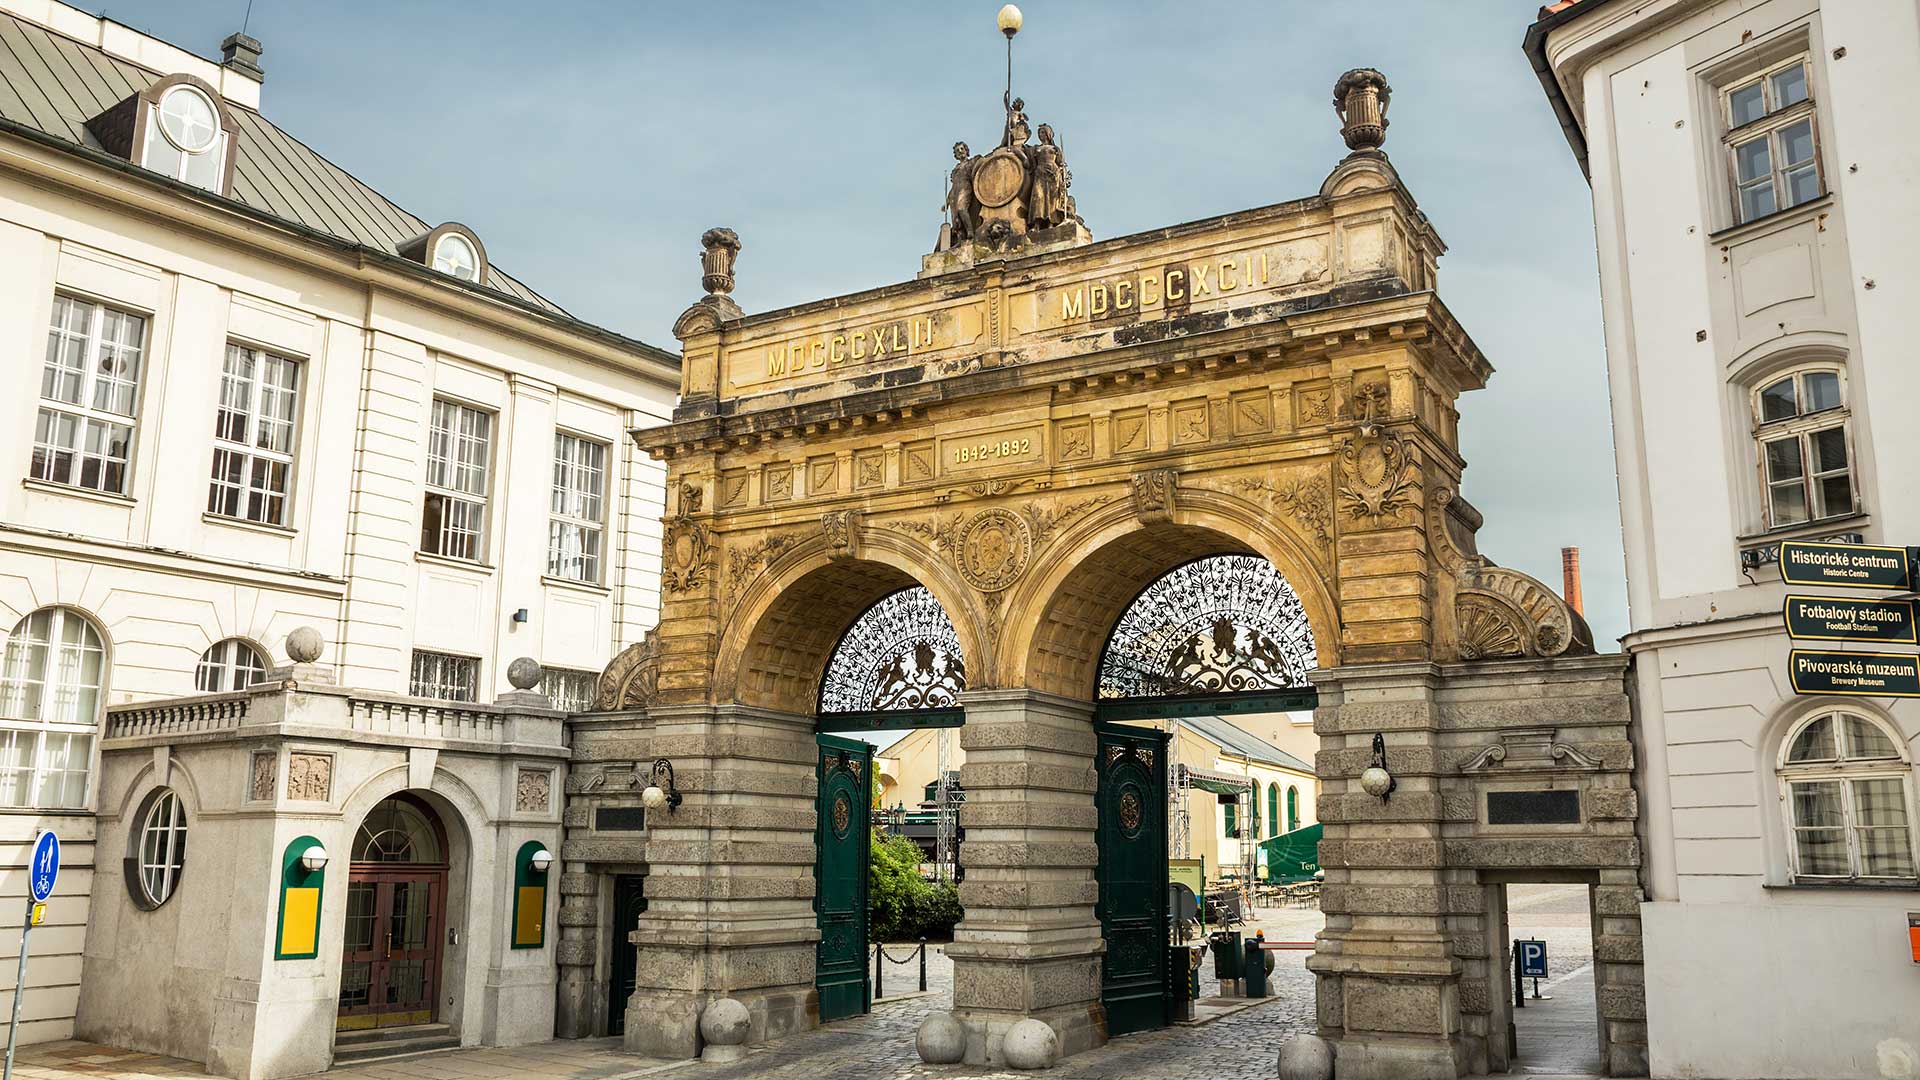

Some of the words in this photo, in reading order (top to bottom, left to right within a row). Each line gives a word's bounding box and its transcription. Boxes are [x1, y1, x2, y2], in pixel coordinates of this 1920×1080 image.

[1062, 253, 1268, 320] MDCCCXCII
[768, 318, 932, 376] MDCCCXLII
[954, 438, 1030, 463] 1842-1892
[1790, 550, 1849, 566] Historické
[1852, 556, 1899, 569] centrum
[1823, 568, 1848, 577] Historic
[1848, 569, 1869, 578] Centre
[1800, 604, 1857, 623] Fotbalový
[1859, 609, 1902, 622] stadion
[1826, 622, 1852, 631] Football
[1852, 623, 1879, 632] Stadium
[1798, 658, 1863, 674] Pivovarské
[1866, 664, 1915, 676] muzeum
[1831, 676, 1858, 687] Brewery
[1858, 677, 1885, 687] Museum
[1300, 861, 1316, 871] Ten
[1525, 943, 1541, 967] P
